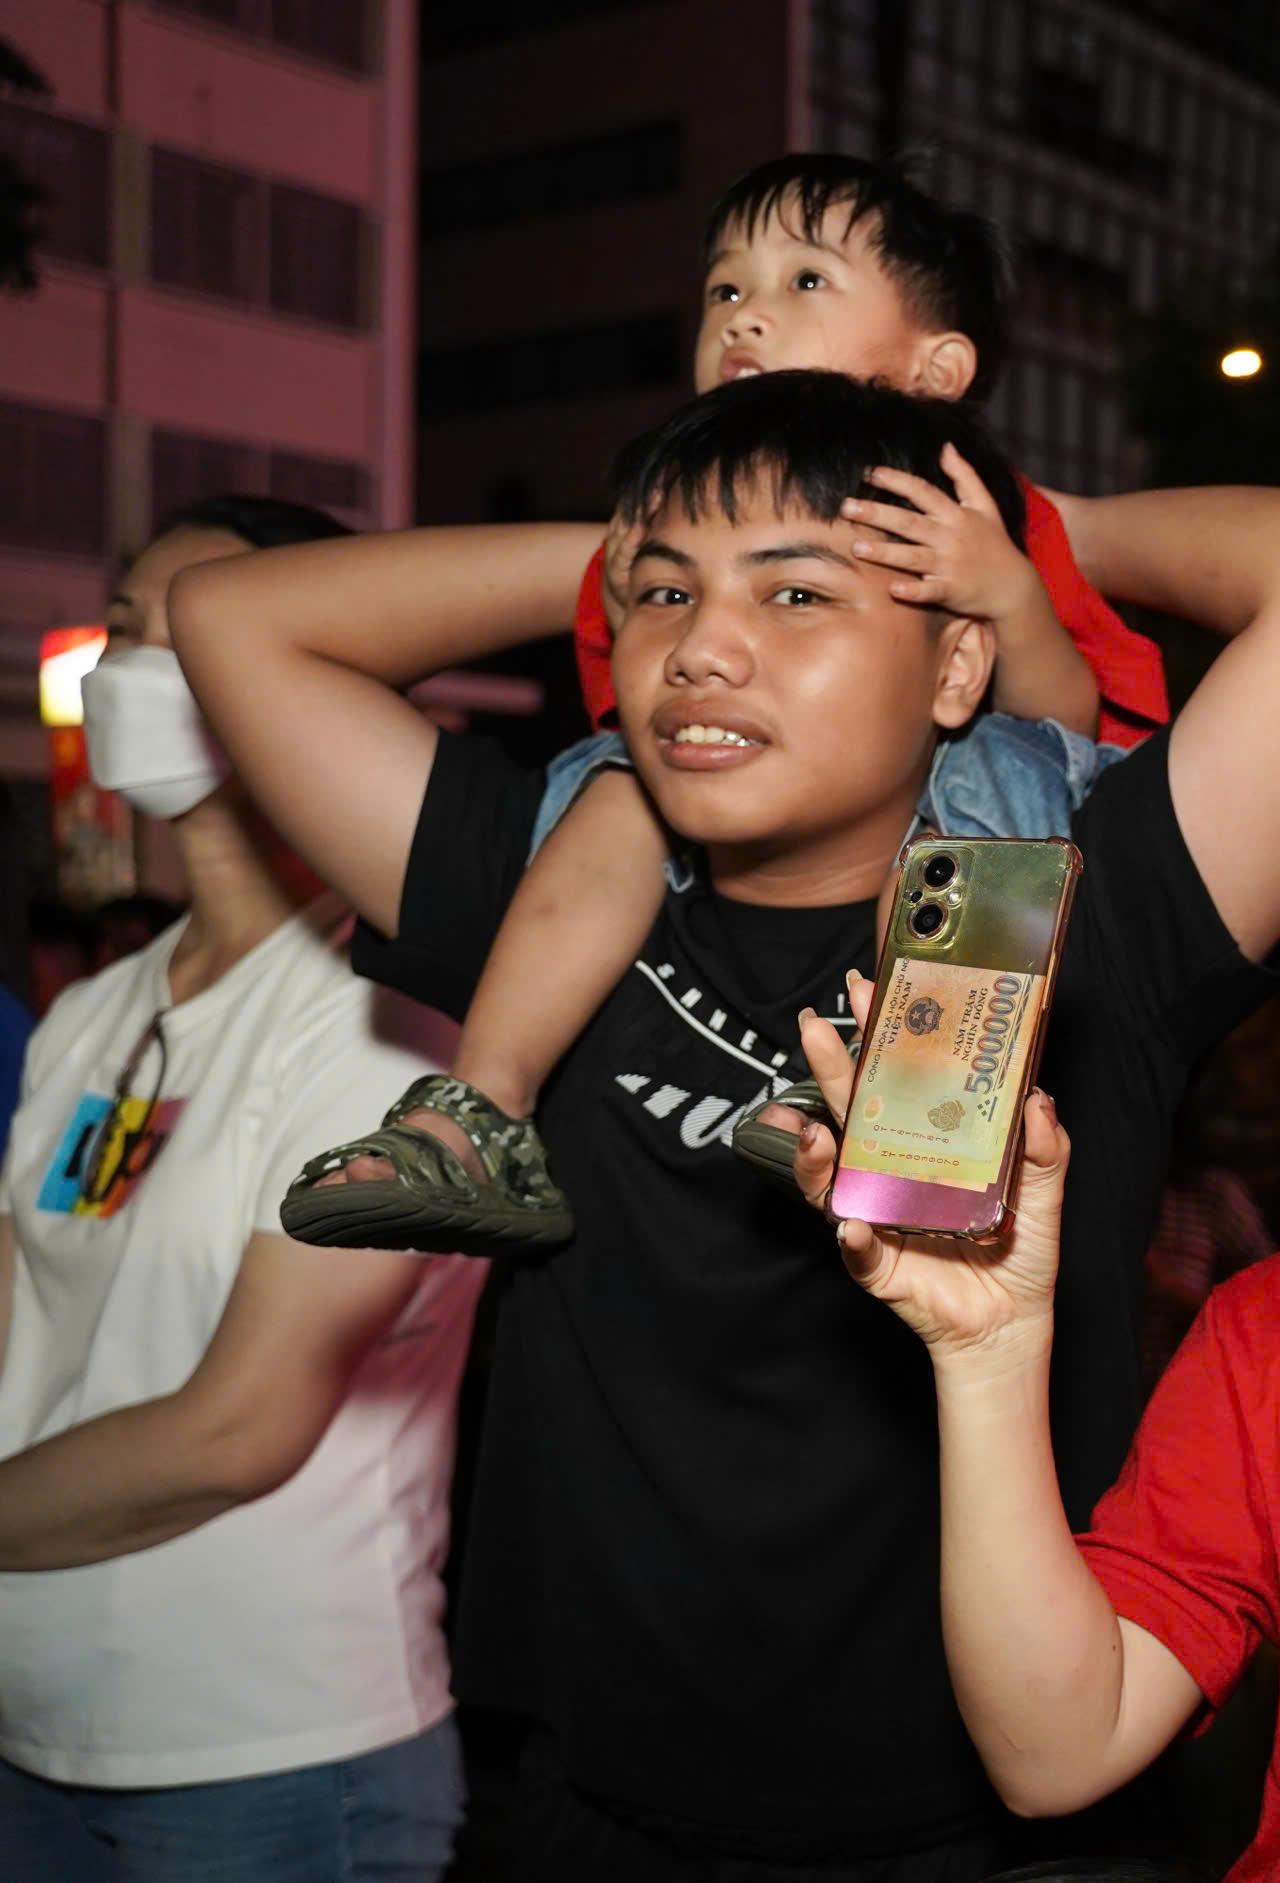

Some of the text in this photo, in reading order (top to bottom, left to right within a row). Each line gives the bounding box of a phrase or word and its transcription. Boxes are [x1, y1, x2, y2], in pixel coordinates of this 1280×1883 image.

[888, 982, 912, 1044] VIỆT NAM
[953, 989, 977, 1056] NĂM TRĂM
[961, 987, 988, 1061] NGHÌN ĐỒNG
